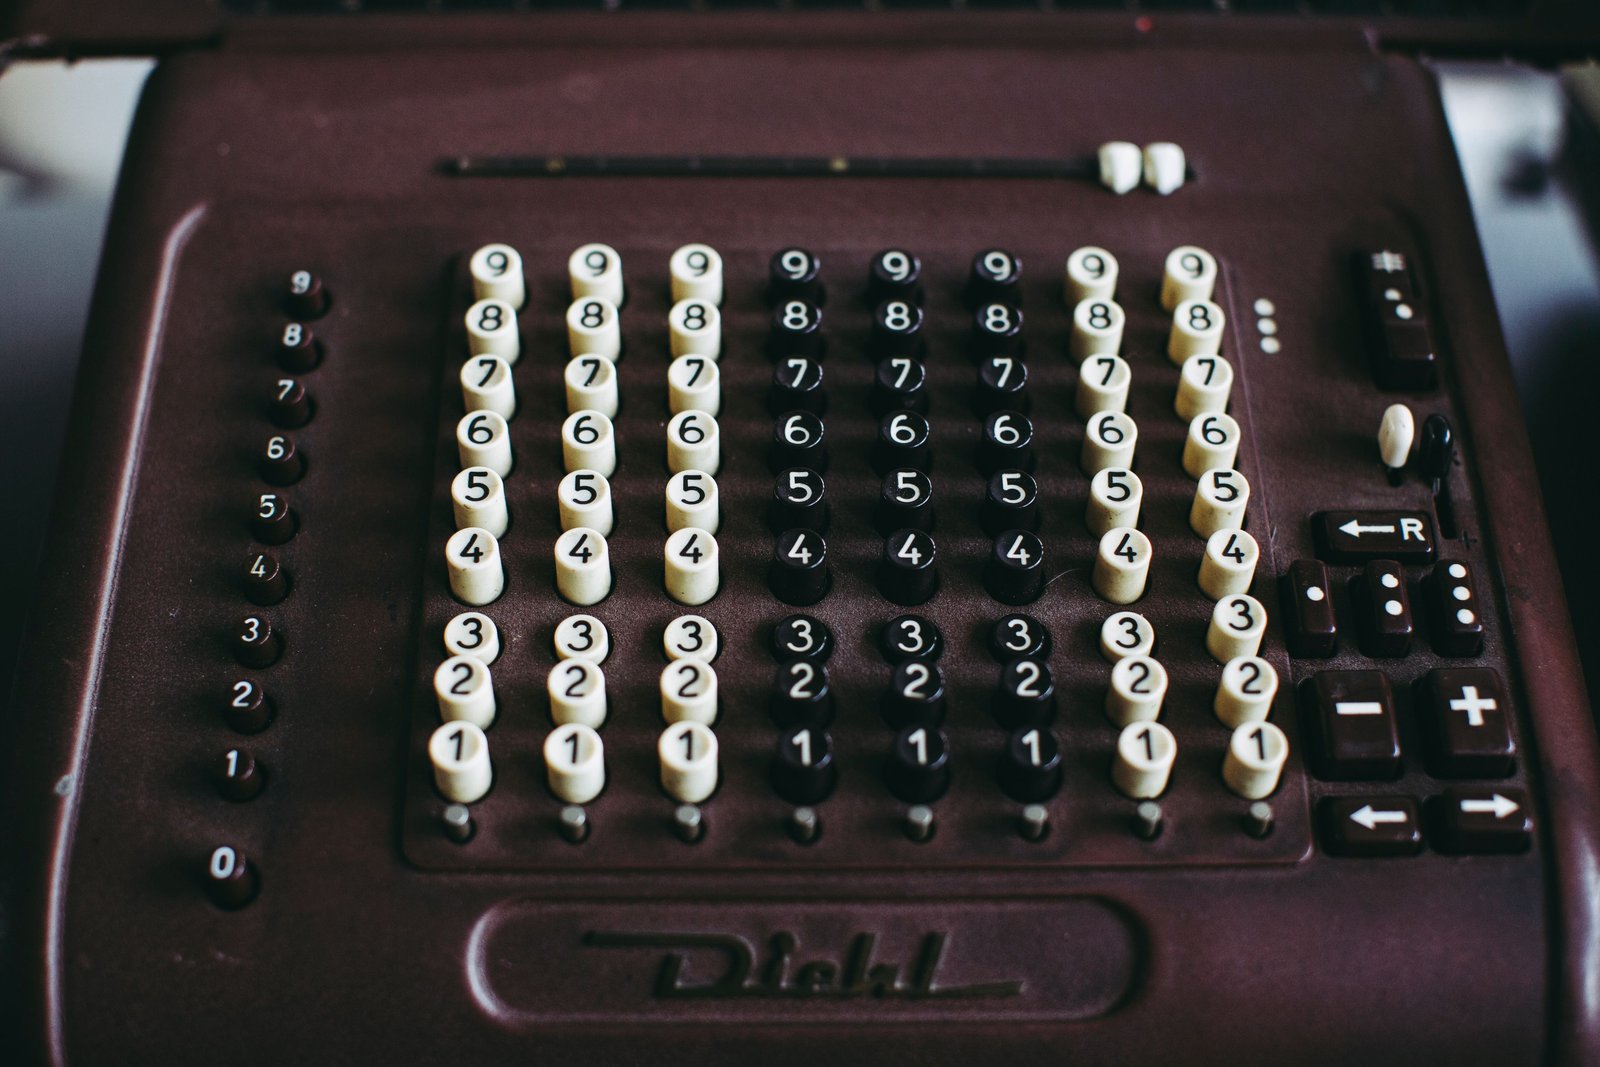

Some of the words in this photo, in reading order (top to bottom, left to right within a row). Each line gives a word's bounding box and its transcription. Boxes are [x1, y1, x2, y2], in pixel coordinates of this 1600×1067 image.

[486, 251, 510, 276] 9
[585, 250, 609, 276] 9
[687, 251, 710, 276] 9
[781, 250, 809, 280] 9
[882, 251, 910, 281] 9
[984, 251, 1011, 281] 9
[1082, 252, 1107, 278] 9
[1180, 252, 1205, 277] 9
[292, 270, 311, 294] 9
[478, 304, 503, 332] 8
[580, 301, 605, 329] 8
[683, 303, 707, 331] 8
[782, 301, 809, 330] 8
[884, 301, 911, 331] 8
[985, 304, 1011, 333] 8
[1088, 303, 1112, 329] 8
[1189, 304, 1212, 330] 8
[283, 323, 302, 347] 8
[477, 359, 498, 388] 7
[581, 358, 601, 387] 7
[686, 358, 705, 387] 7
[787, 358, 808, 388] 7
[891, 358, 911, 389] 7
[992, 358, 1013, 388] 7
[1096, 358, 1116, 386] 7
[1197, 358, 1216, 386] 7
[278, 379, 294, 400] 7
[467, 415, 494, 445] 6
[573, 415, 600, 445] 6
[678, 415, 705, 445] 6
[784, 415, 810, 445] 6
[890, 414, 916, 444] 6
[993, 415, 1020, 445] 6
[1098, 415, 1124, 445] 6
[1201, 416, 1228, 446] 6
[267, 436, 284, 459] 6
[464, 471, 490, 502] 5
[572, 474, 598, 505] 5
[680, 474, 706, 505] 5
[787, 471, 813, 503] 5
[895, 471, 920, 503] 5
[1001, 473, 1026, 504] 5
[1106, 471, 1131, 503] 5
[1213, 471, 1239, 503] 5
[258, 494, 276, 518] 5
[1400, 517, 1426, 542] R
[459, 533, 484, 564] 4
[568, 533, 593, 564] 4
[679, 533, 704, 564] 4
[787, 533, 812, 564] 4
[897, 533, 922, 565] 4
[1006, 534, 1031, 566] 4
[1113, 532, 1138, 564] 4
[1221, 533, 1246, 564] 4
[250, 554, 266, 578] 4
[241, 617, 260, 642] 3
[1228, 598, 1255, 632] 3
[456, 617, 484, 650] 3
[567, 619, 594, 652] 3
[676, 620, 703, 653] 3
[786, 619, 813, 652] 3
[897, 619, 923, 652] 3
[1005, 618, 1031, 651] 3
[1115, 616, 1142, 649] 3
[450, 662, 474, 696] 2
[565, 664, 588, 698] 2
[677, 664, 700, 698] 2
[789, 662, 814, 698] 2
[903, 663, 929, 698] 2
[1016, 661, 1040, 697] 2
[1128, 661, 1151, 694] 2
[1239, 661, 1262, 695] 2
[232, 681, 253, 707] 2
[449, 729, 464, 762] 1
[564, 732, 579, 764] 1
[678, 729, 694, 761] 1
[792, 729, 811, 765] 1
[908, 728, 927, 764] 1
[1022, 730, 1040, 765] 1
[1137, 728, 1153, 761] 1
[1249, 727, 1265, 761] 1
[226, 750, 238, 777] 1
[210, 846, 236, 879] 0
